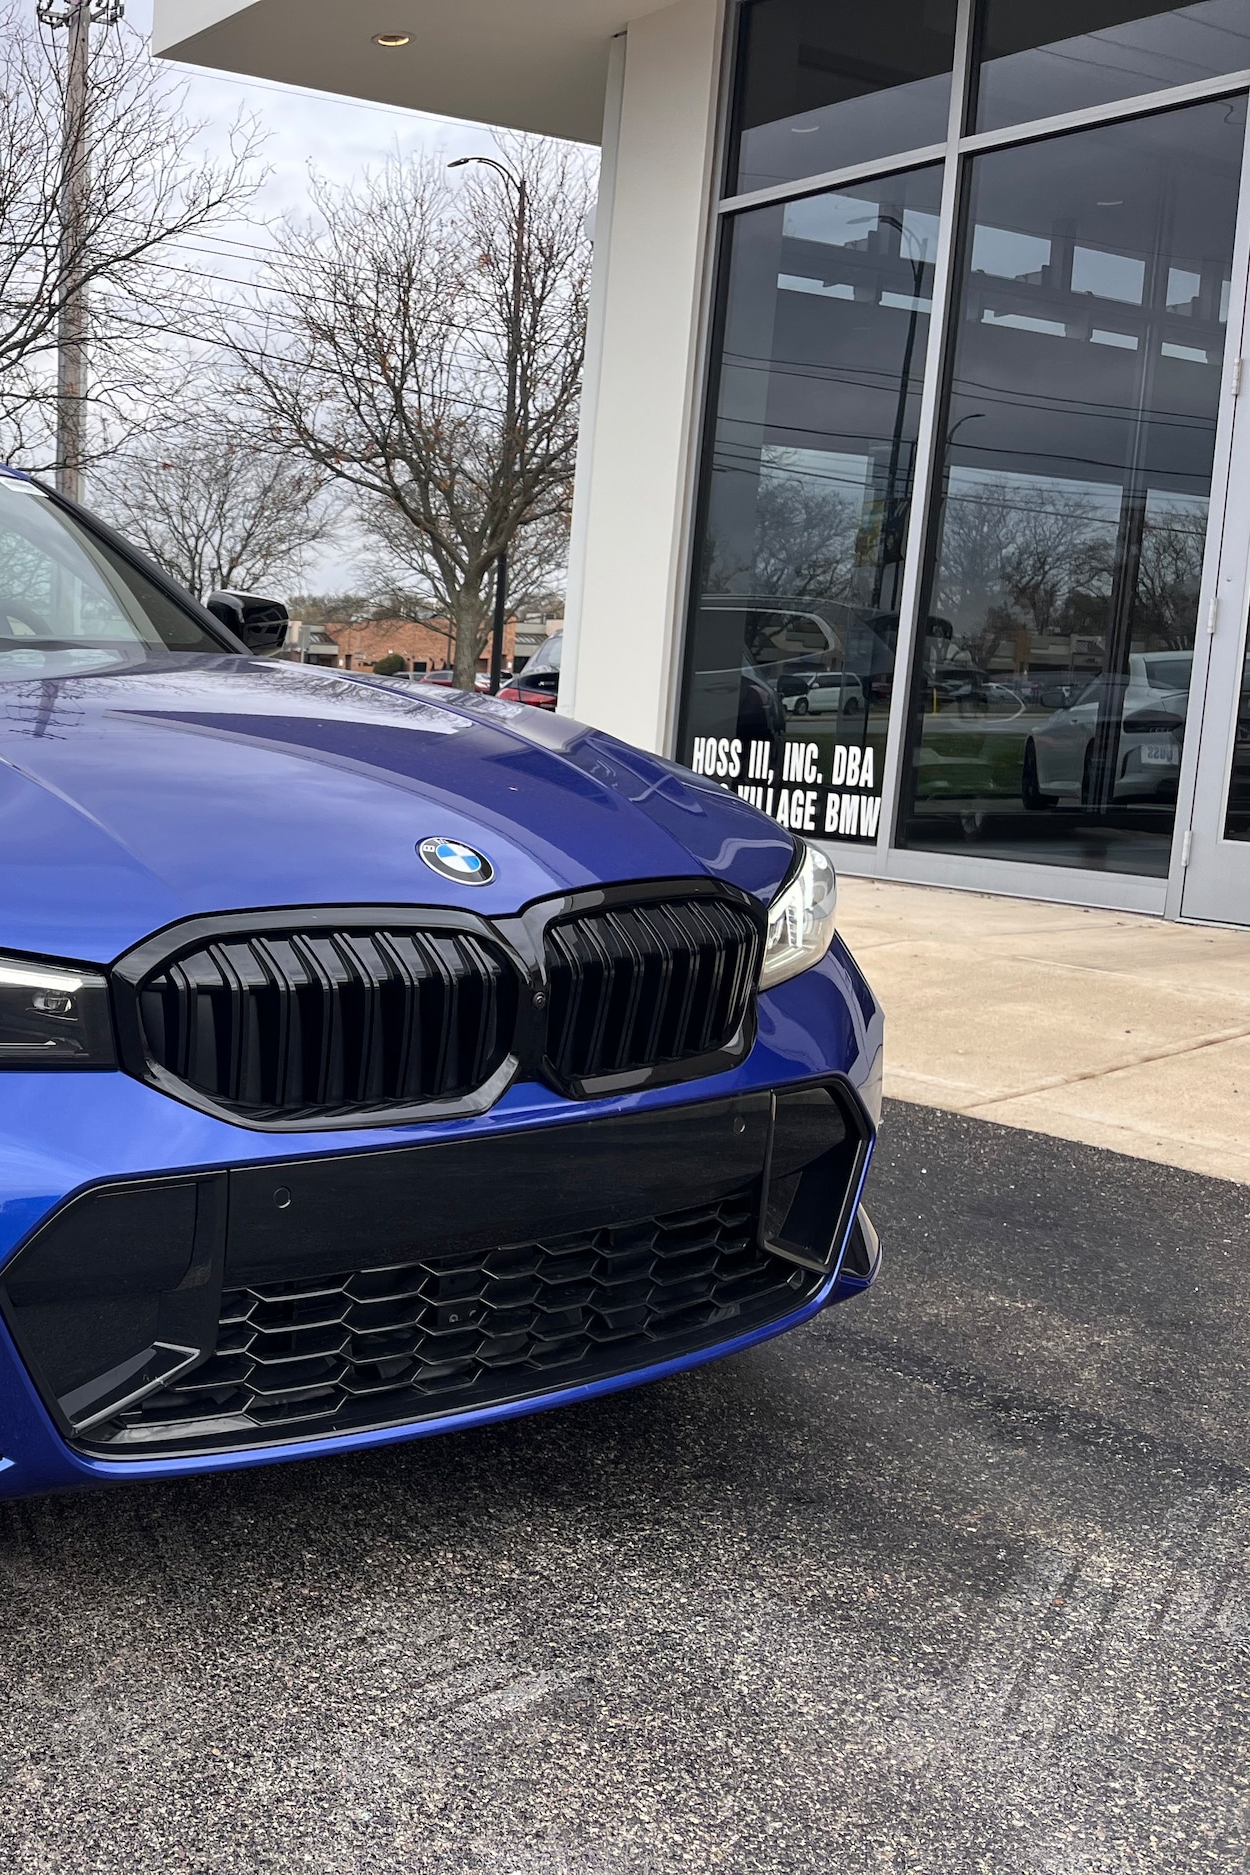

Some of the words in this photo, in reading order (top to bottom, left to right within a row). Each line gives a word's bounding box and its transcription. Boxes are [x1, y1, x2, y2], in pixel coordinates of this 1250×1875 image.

[692, 737, 743, 777] HOSS
[748, 740, 774, 785] III,
[782, 742, 823, 784] INC.
[831, 745, 874, 788] DBA
[824, 793, 882, 837] BMW
